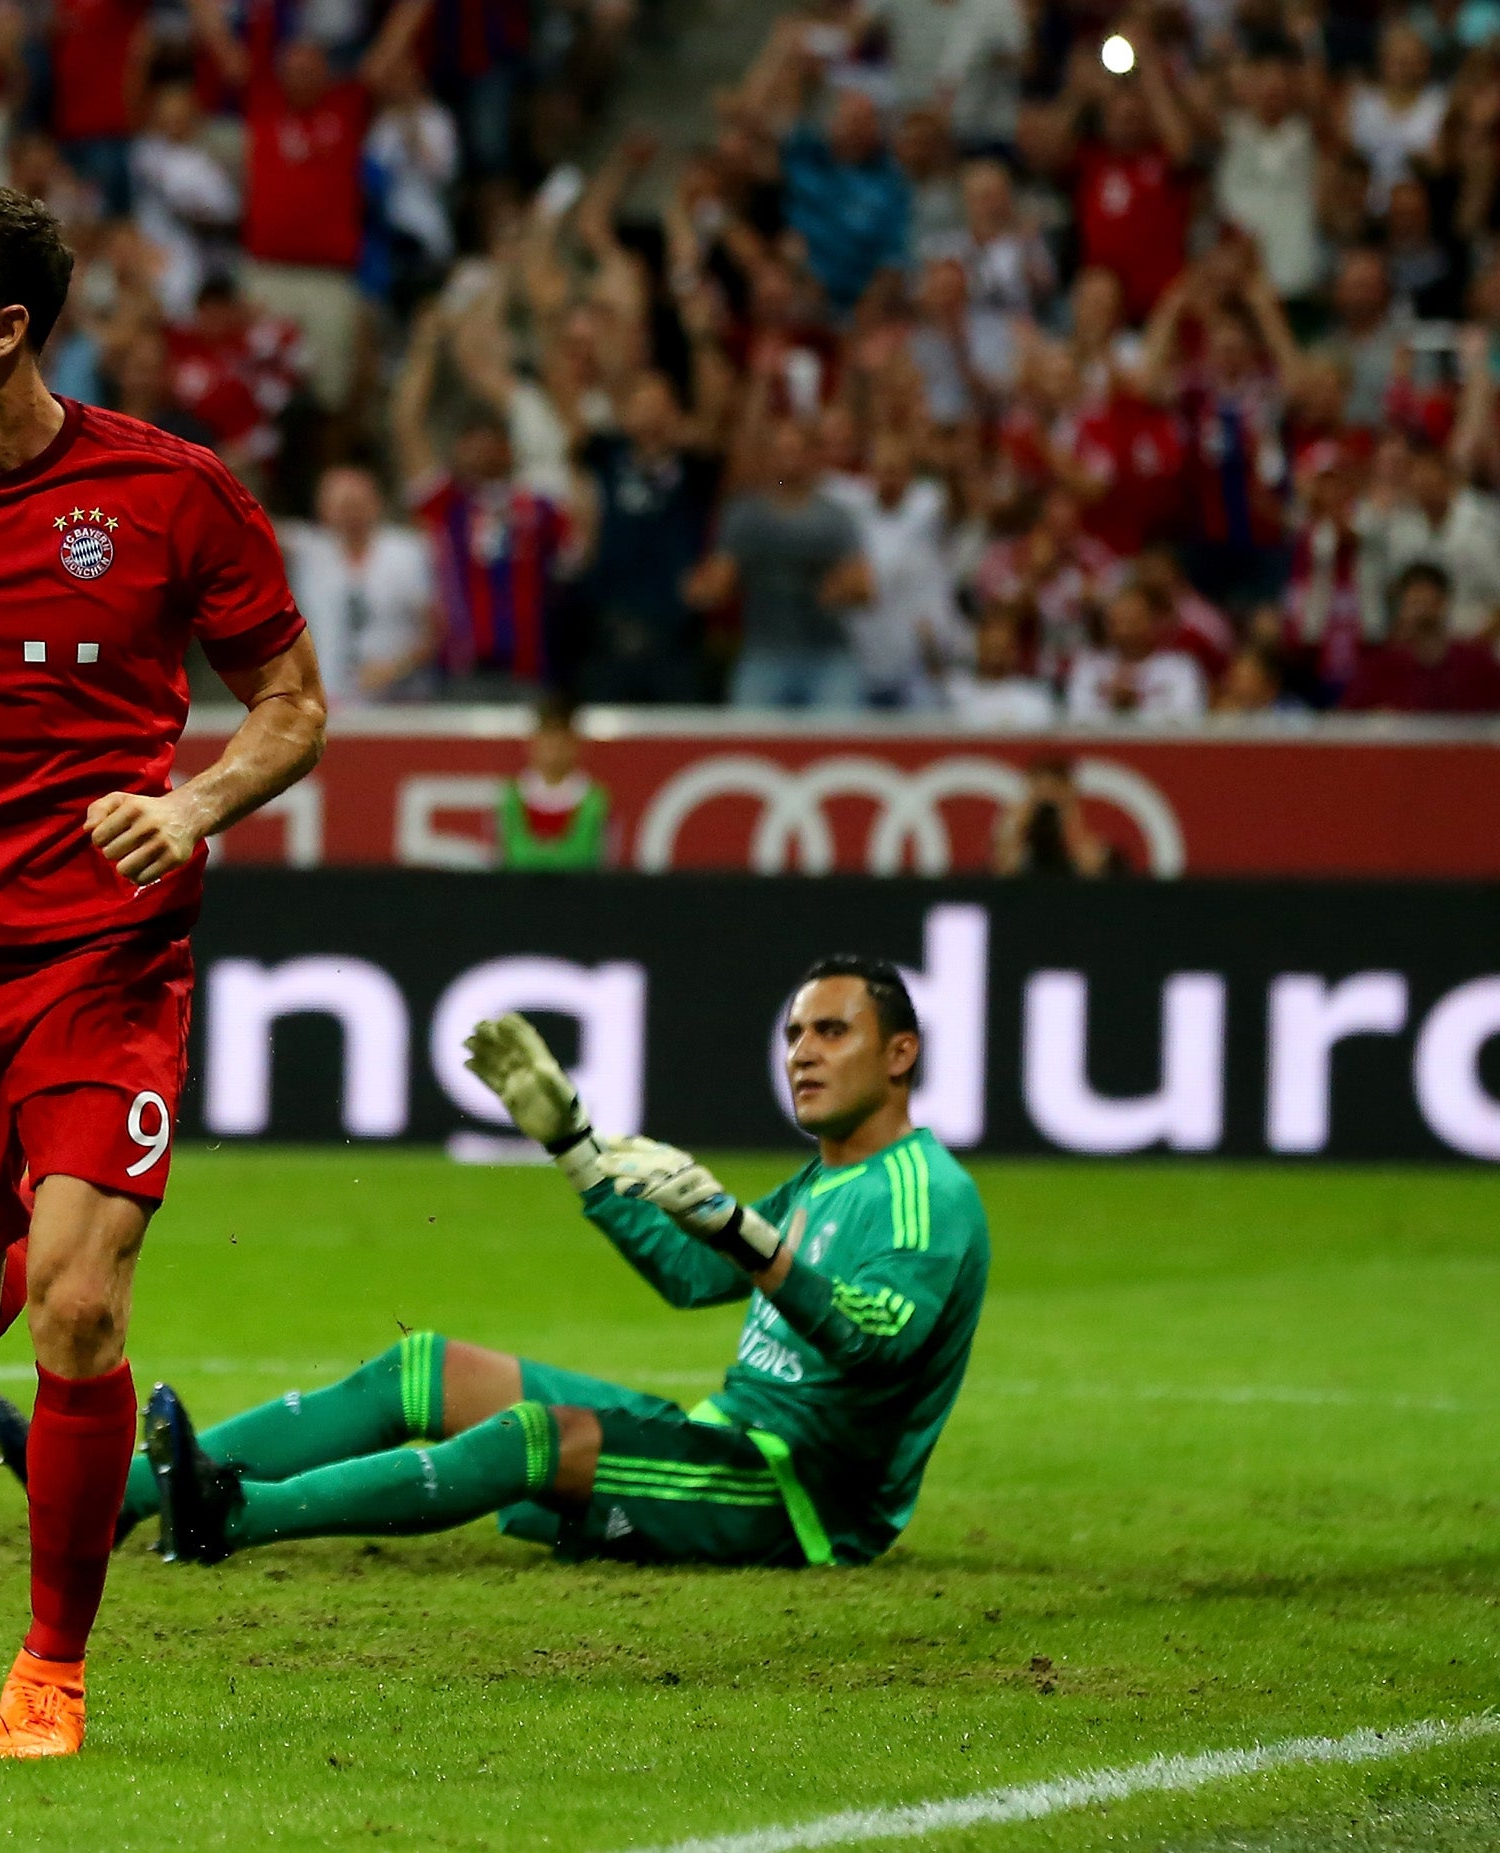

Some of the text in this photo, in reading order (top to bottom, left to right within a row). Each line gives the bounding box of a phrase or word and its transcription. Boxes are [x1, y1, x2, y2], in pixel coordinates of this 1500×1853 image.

[63, 528, 111, 551] FC BAYERN
[126, 1090, 170, 1177] 9
